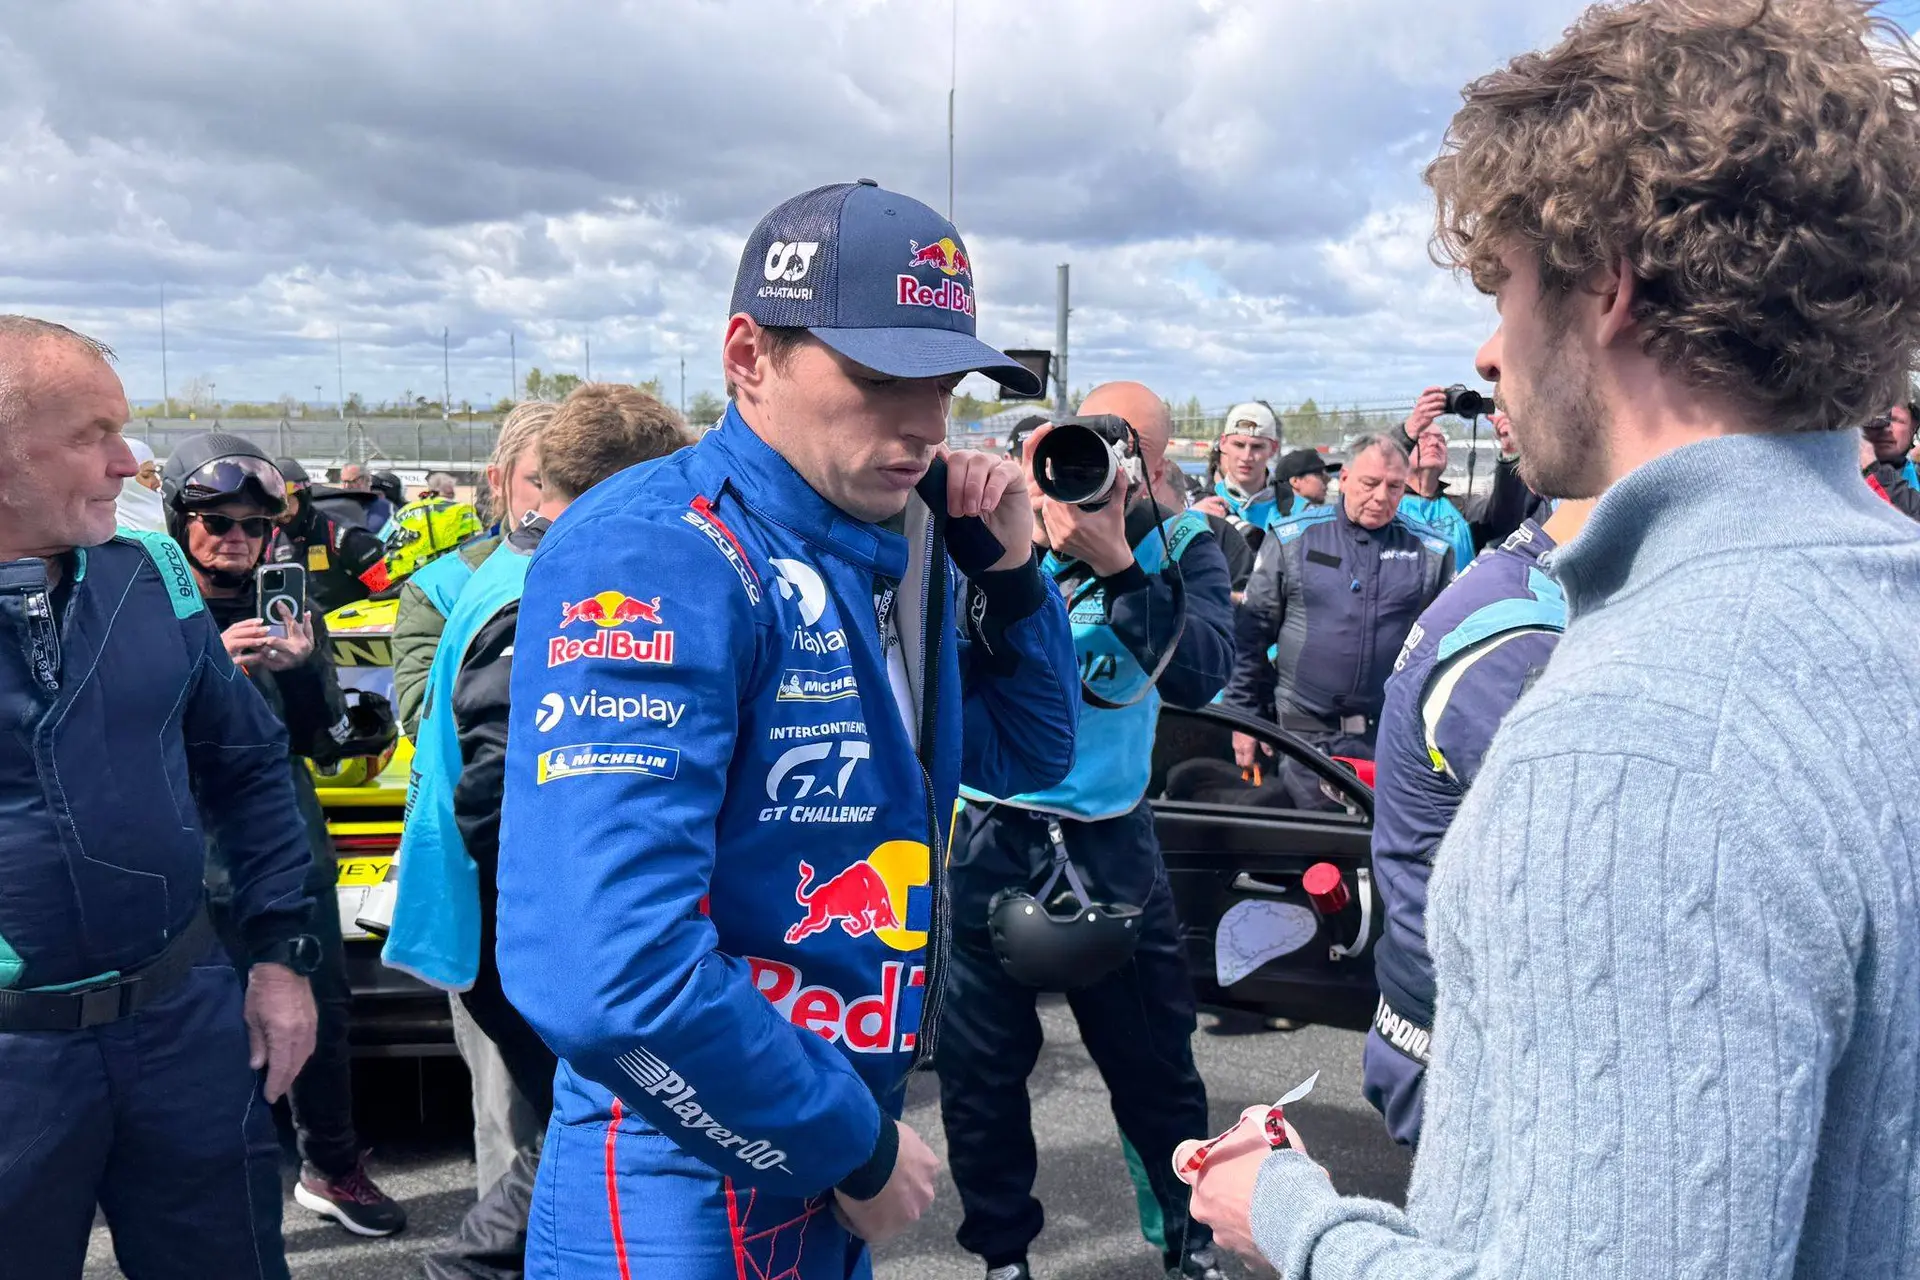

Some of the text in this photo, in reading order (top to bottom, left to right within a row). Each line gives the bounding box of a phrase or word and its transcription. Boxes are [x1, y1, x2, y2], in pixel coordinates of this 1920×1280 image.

[757, 287, 812, 300] ALPHATAURI
[897, 274, 950, 309] Red
[161, 542, 194, 598] sparco
[681, 512, 760, 606] sparco
[548, 630, 674, 668] Red Bull
[569, 689, 686, 728] viaplay
[572, 754, 667, 768] MICHELIN
[759, 805, 876, 823] GT CHALLENGE
